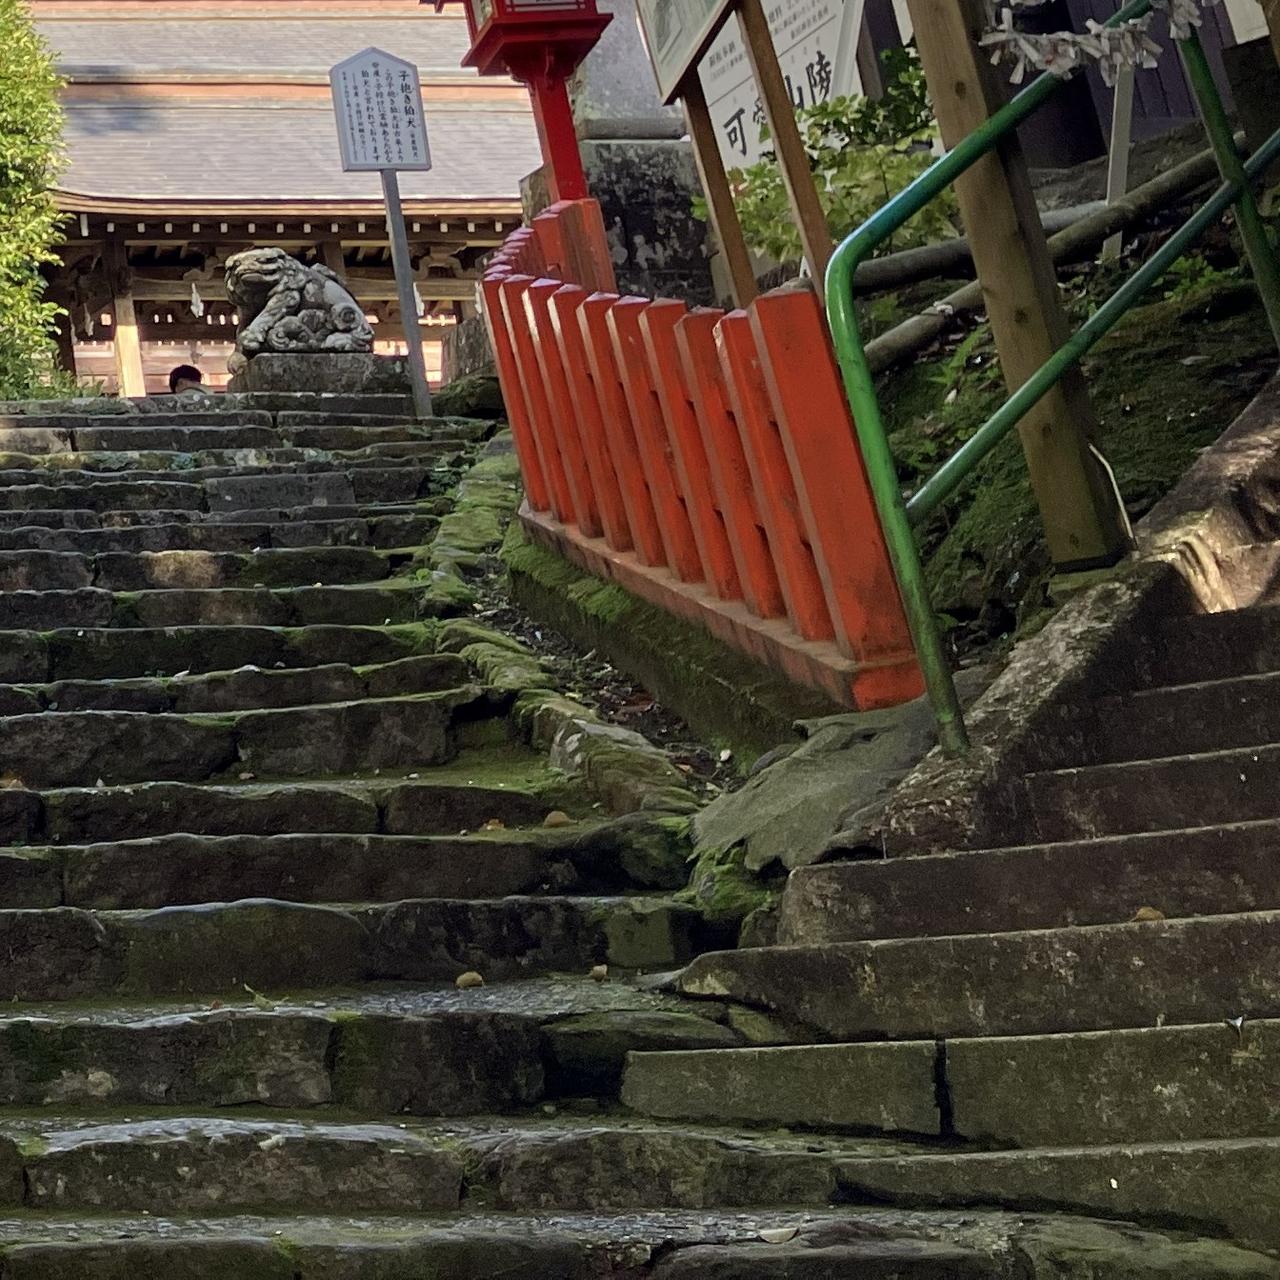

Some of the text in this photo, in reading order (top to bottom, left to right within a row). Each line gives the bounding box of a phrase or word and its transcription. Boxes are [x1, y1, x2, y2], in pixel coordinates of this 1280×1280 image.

[398, 71, 417, 128] 子抱き狛犬
